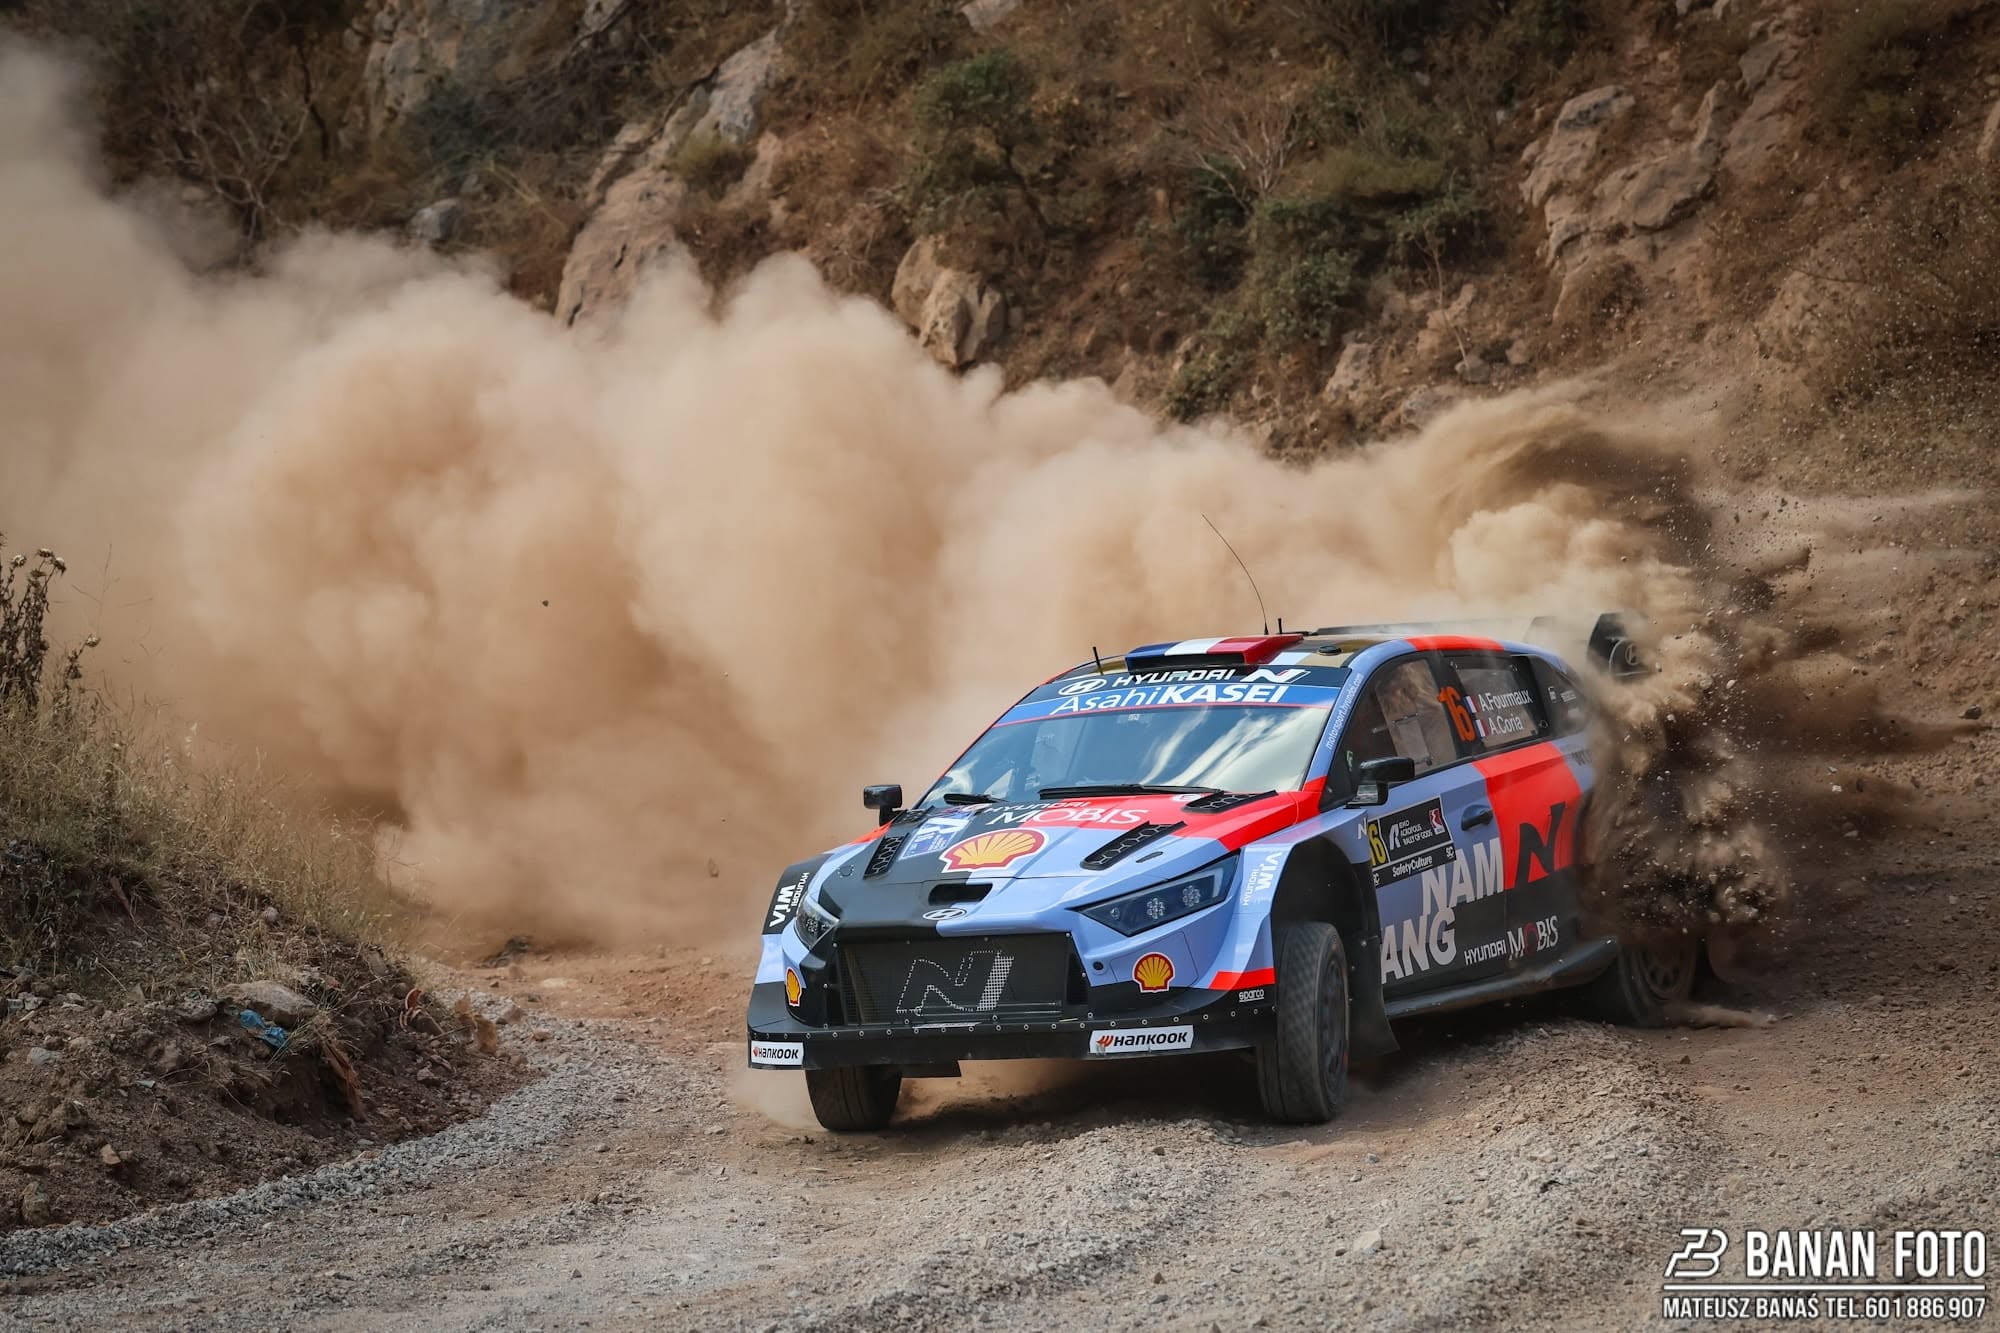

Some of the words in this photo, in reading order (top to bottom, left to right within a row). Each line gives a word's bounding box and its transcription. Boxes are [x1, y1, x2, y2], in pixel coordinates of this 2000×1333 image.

[1112, 669, 1236, 688] HYUNDAI
[1478, 689, 1533, 712] A.Fourmaux
[1437, 686, 1476, 742] 16
[1488, 714, 1524, 736] A.Coria
[983, 801, 1091, 813] HYUNDAI
[985, 808, 1148, 826] MOBIS
[1392, 855, 1433, 877] SafetyCulture
[1422, 838, 1504, 915] NAM
[790, 872, 810, 907] HYUNDAI
[1242, 869, 1259, 905] HYUNDAI
[1463, 939, 1507, 967] HYUNDAI
[1507, 915, 1559, 961] MOBIS
[1239, 989, 1265, 1001] sparco
